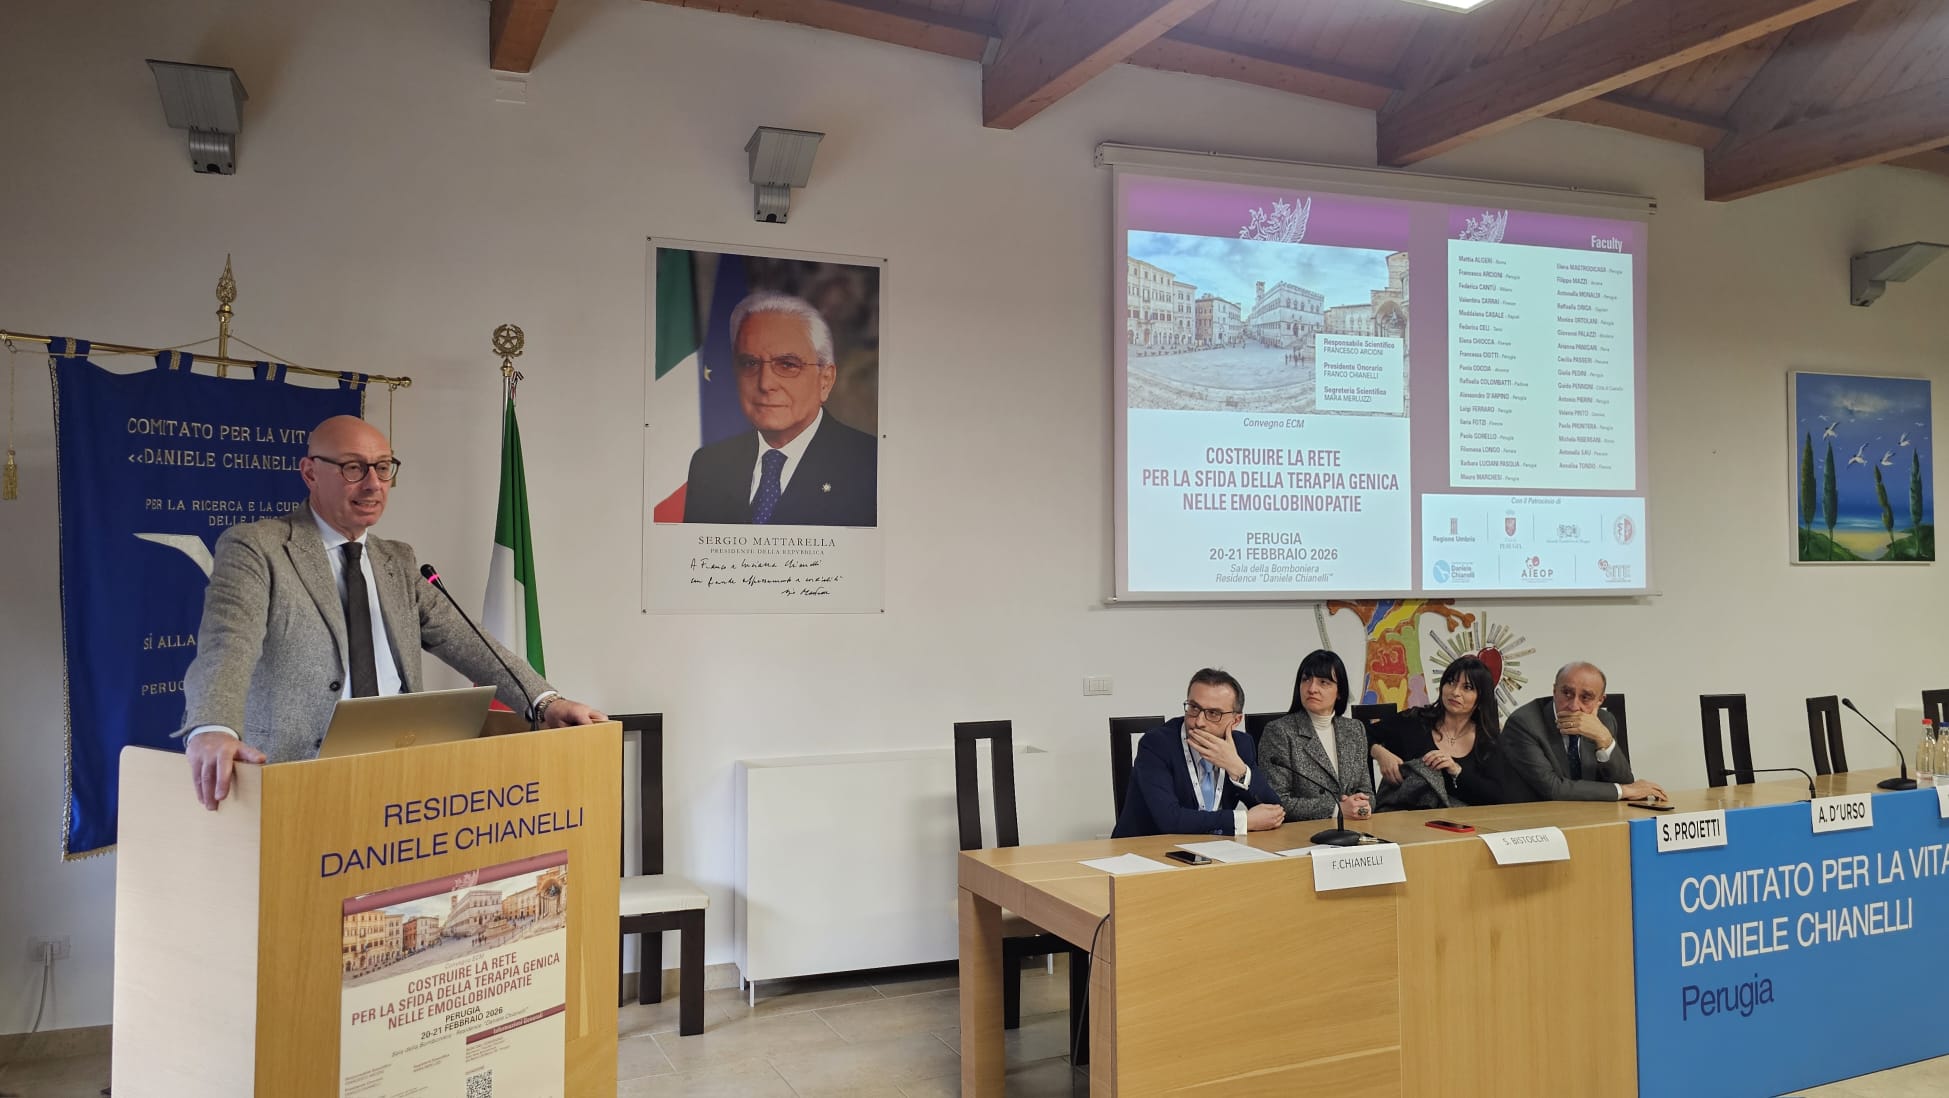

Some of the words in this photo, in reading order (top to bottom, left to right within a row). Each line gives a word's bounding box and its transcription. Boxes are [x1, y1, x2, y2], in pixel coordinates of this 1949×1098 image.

[1591, 235, 1623, 253] Faculty
[1323, 338, 1363, 347] Responsabile
[1364, 340, 1395, 349] Scientifico
[1323, 346, 1358, 355] FRANCESCO
[1360, 347, 1384, 356] ARCIONI
[1323, 362, 1355, 370] Presidente
[1356, 363, 1383, 372] Onorario
[1323, 370, 1348, 378] FRANCO
[1349, 371, 1379, 379] CHIANELLI
[1324, 385, 1355, 395] Segreteria
[1356, 387, 1387, 396] Scientifica
[1343, 395, 1372, 403] MERLUZZI
[127, 417, 213, 439] COMITATO
[219, 426, 251, 442] PER
[256, 427, 275, 443] LA
[279, 428, 309, 445] VIT
[1243, 417, 1284, 430] Convegno
[1285, 418, 1305, 429] ECM
[223, 452, 301, 471] CHIANELL
[1205, 447, 1284, 466] COSTRUIRE
[1287, 449, 1303, 467] LA
[1308, 449, 1341, 467] RETE
[1142, 468, 1169, 487] PER
[1173, 469, 1190, 487] LA
[1194, 470, 1237, 488] SFIDA
[1240, 471, 1284, 489] DELLA
[1287, 471, 1345, 490] TERAPIA
[1348, 473, 1400, 491] GENICA
[145, 498, 162, 510] PER
[167, 500, 185, 511] LA
[192, 500, 243, 512] RICERCA
[248, 501, 256, 512] E
[260, 501, 273, 512] LA
[276, 501, 300, 512] CUR
[1183, 493, 1227, 511] NELLE
[1230, 493, 1362, 512] EMOGLOBINOPATIE
[698, 535, 748, 546] SERGIO
[753, 536, 837, 548] MATTARELLA
[1246, 532, 1302, 545] PERUGIA
[1209, 548, 1242, 561] 20-21
[1246, 547, 1307, 561] FEBBRAIO
[1310, 548, 1339, 561] 2026
[1230, 563, 1248, 573] Sala
[1249, 563, 1270, 573] della
[1271, 563, 1320, 573] Bomboniera
[1521, 569, 1554, 578] AIEOP
[1215, 573, 1257, 583] Residence
[157, 634, 197, 649] ALLA
[384, 781, 540, 828] RESIDENCE
[1818, 806, 1828, 824] A.
[1829, 801, 1866, 821] D'URSO
[1662, 823, 1673, 843] S.
[1674, 818, 1721, 841] PROIETTI
[320, 832, 449, 878] DANIELE
[455, 807, 584, 850] CHIANELLI
[1502, 836, 1510, 846] S.
[1511, 834, 1550, 846] BISTOCCHI
[1680, 861, 1814, 913] COMITATO
[1822, 855, 1870, 893] PER
[1877, 850, 1905, 885] LA
[1681, 916, 1789, 967] DANIELE
[1796, 897, 1913, 947] CHIANELLI
[408, 963, 472, 994] COSTRUIRE
[475, 960, 488, 974] LA
[491, 951, 517, 969] RETE
[351, 1006, 376, 1026] PER
[380, 1002, 395, 1021] LA
[398, 991, 433, 1012] SFIDA
[437, 979, 471, 1000] DELLA
[475, 965, 520, 988] TERAPIA
[523, 952, 560, 974] GENICA
[1682, 972, 1775, 1022] Perugia
[388, 1010, 424, 1030] NELLE
[428, 974, 532, 1017] EMOGLOBINOPATIE
[445, 1005, 481, 1023] PERUGIA
[421, 1026, 442, 1040] 20-21
[444, 1012, 484, 1032] FEBBRAIO
[485, 1007, 503, 1019] 2026
